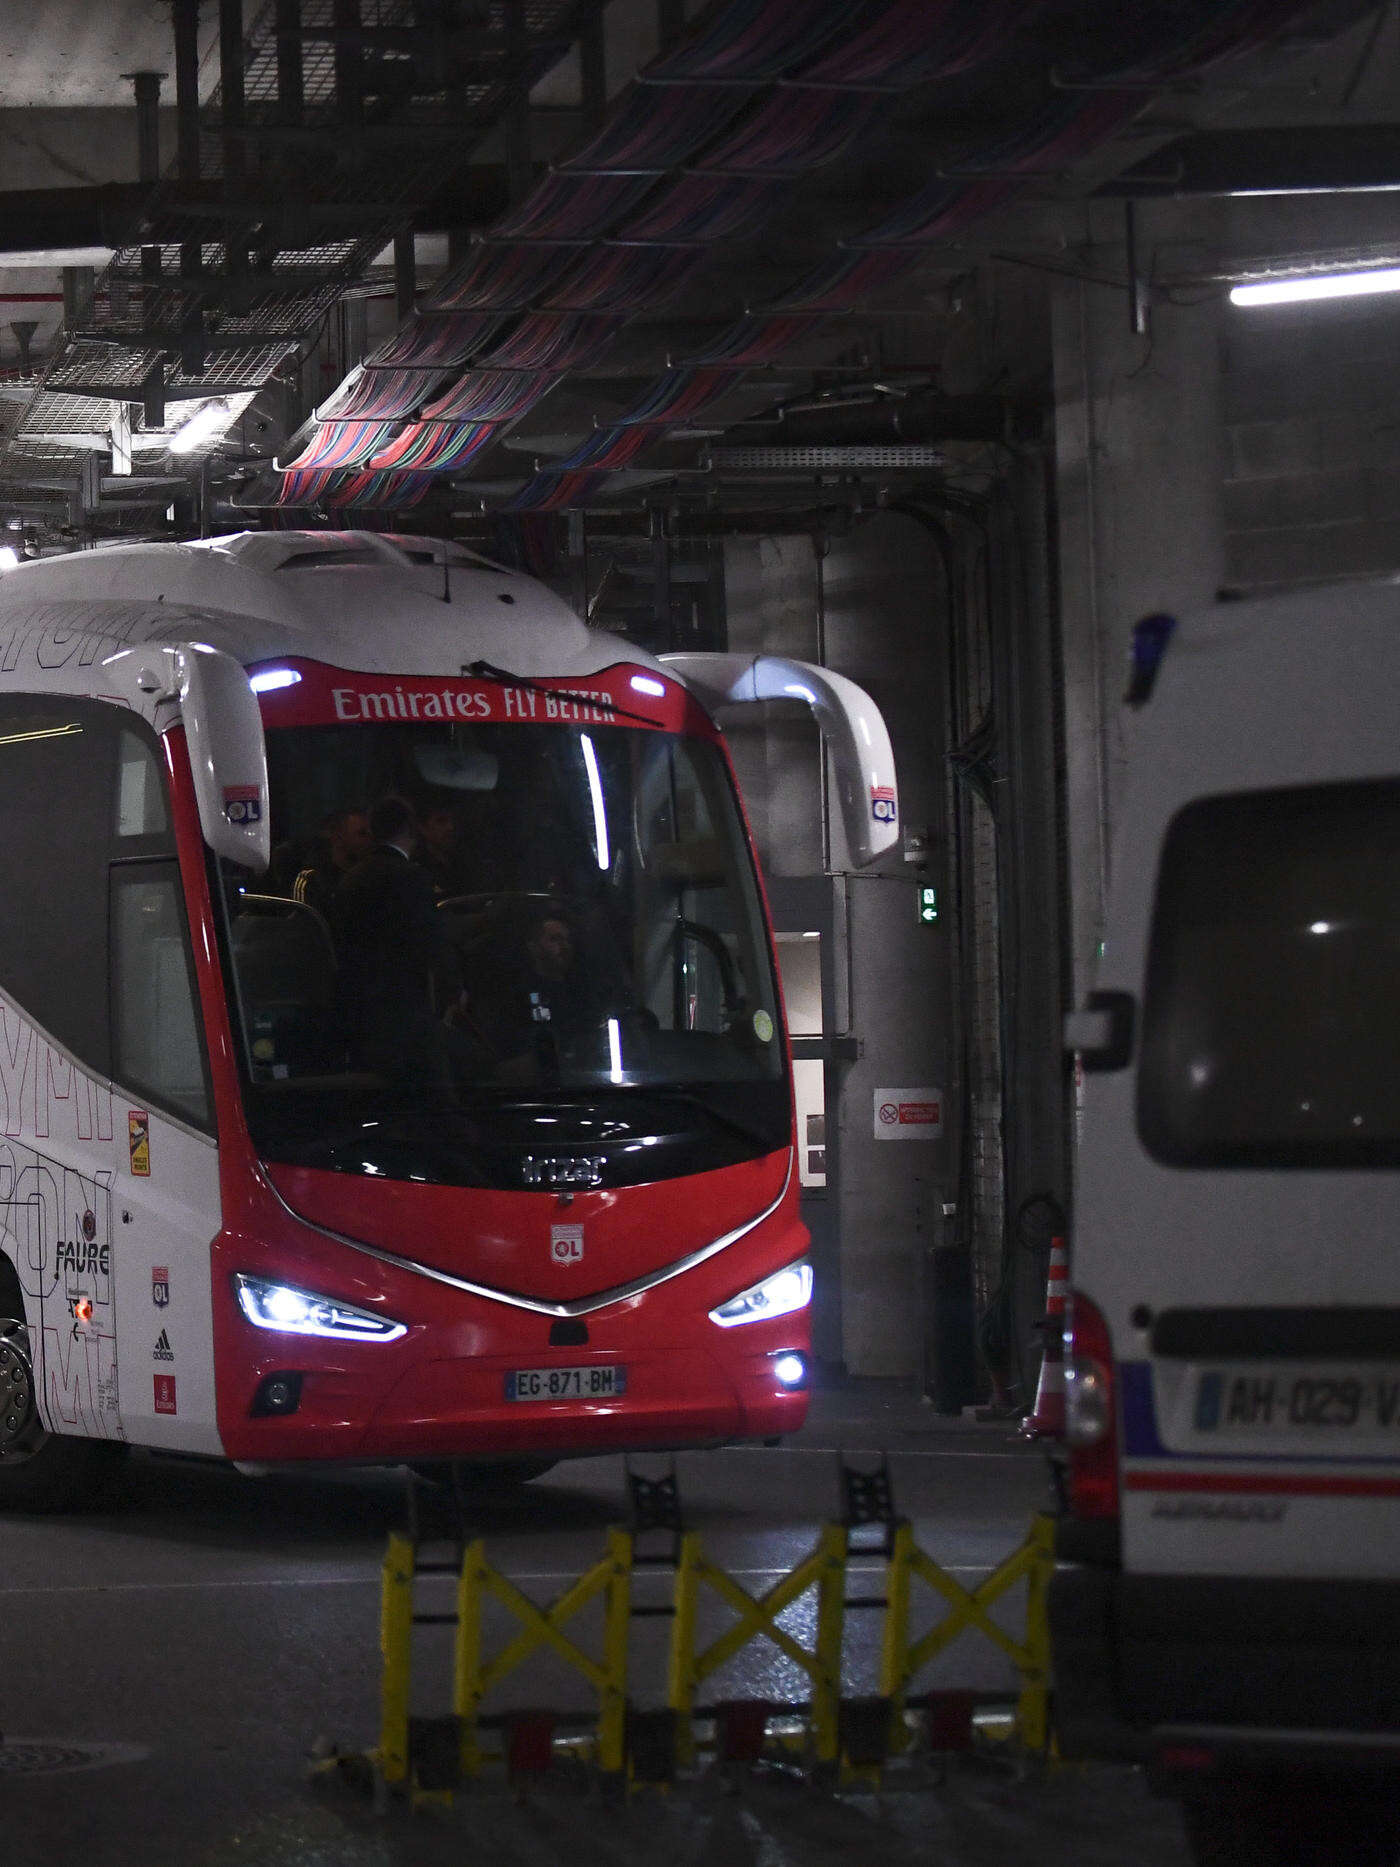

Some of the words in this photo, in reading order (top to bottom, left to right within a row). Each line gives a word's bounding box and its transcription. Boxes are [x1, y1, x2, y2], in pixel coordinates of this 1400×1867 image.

[331, 686, 491, 720] Emirates
[503, 686, 537, 718] FLY
[544, 688, 616, 723] BETTER
[227, 801, 259, 821] OL
[874, 800, 896, 819] OL
[56, 1241, 110, 1276] FAURE
[555, 1240, 580, 1258] OL
[517, 1370, 613, 1396] EG-871-BM
[1227, 1377, 1400, 1428] AH-029-V
